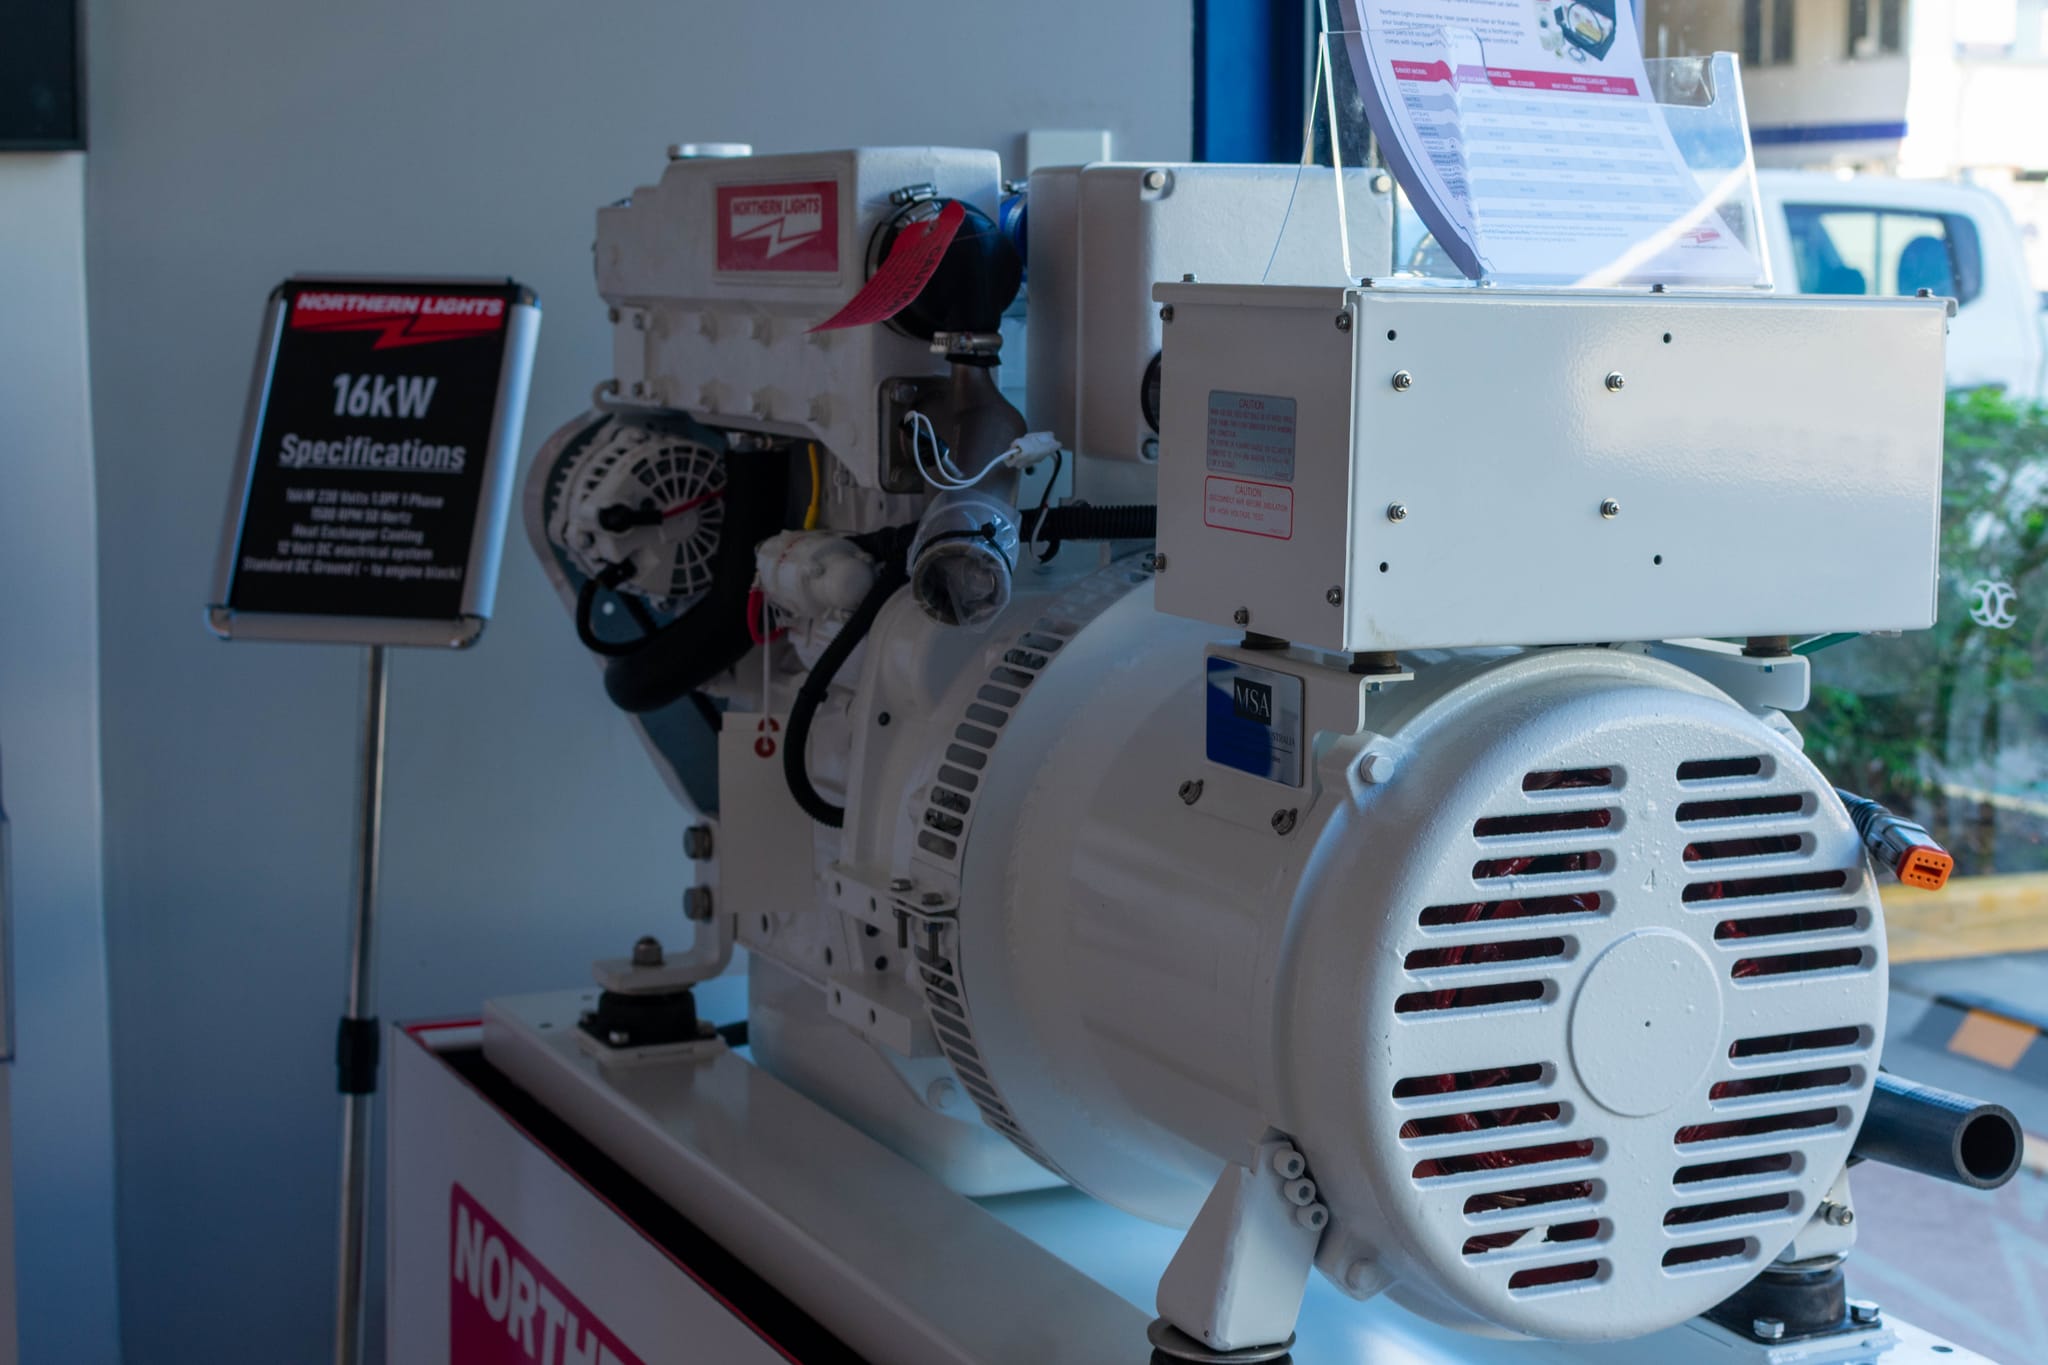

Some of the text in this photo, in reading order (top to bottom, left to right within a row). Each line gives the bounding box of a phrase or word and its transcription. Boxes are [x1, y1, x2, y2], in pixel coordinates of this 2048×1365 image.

[734, 198, 819, 214] NORTHERN LIGHTS
[297, 292, 503, 317] NORTHERN LIGHTS
[333, 372, 438, 418] 16kW
[278, 433, 467, 471] Specifications
[1235, 485, 1262, 497] CAUTION
[380, 526, 424, 546] Cooling
[1236, 684, 1271, 718] MSA
[454, 1202, 626, 1365] NORTH
